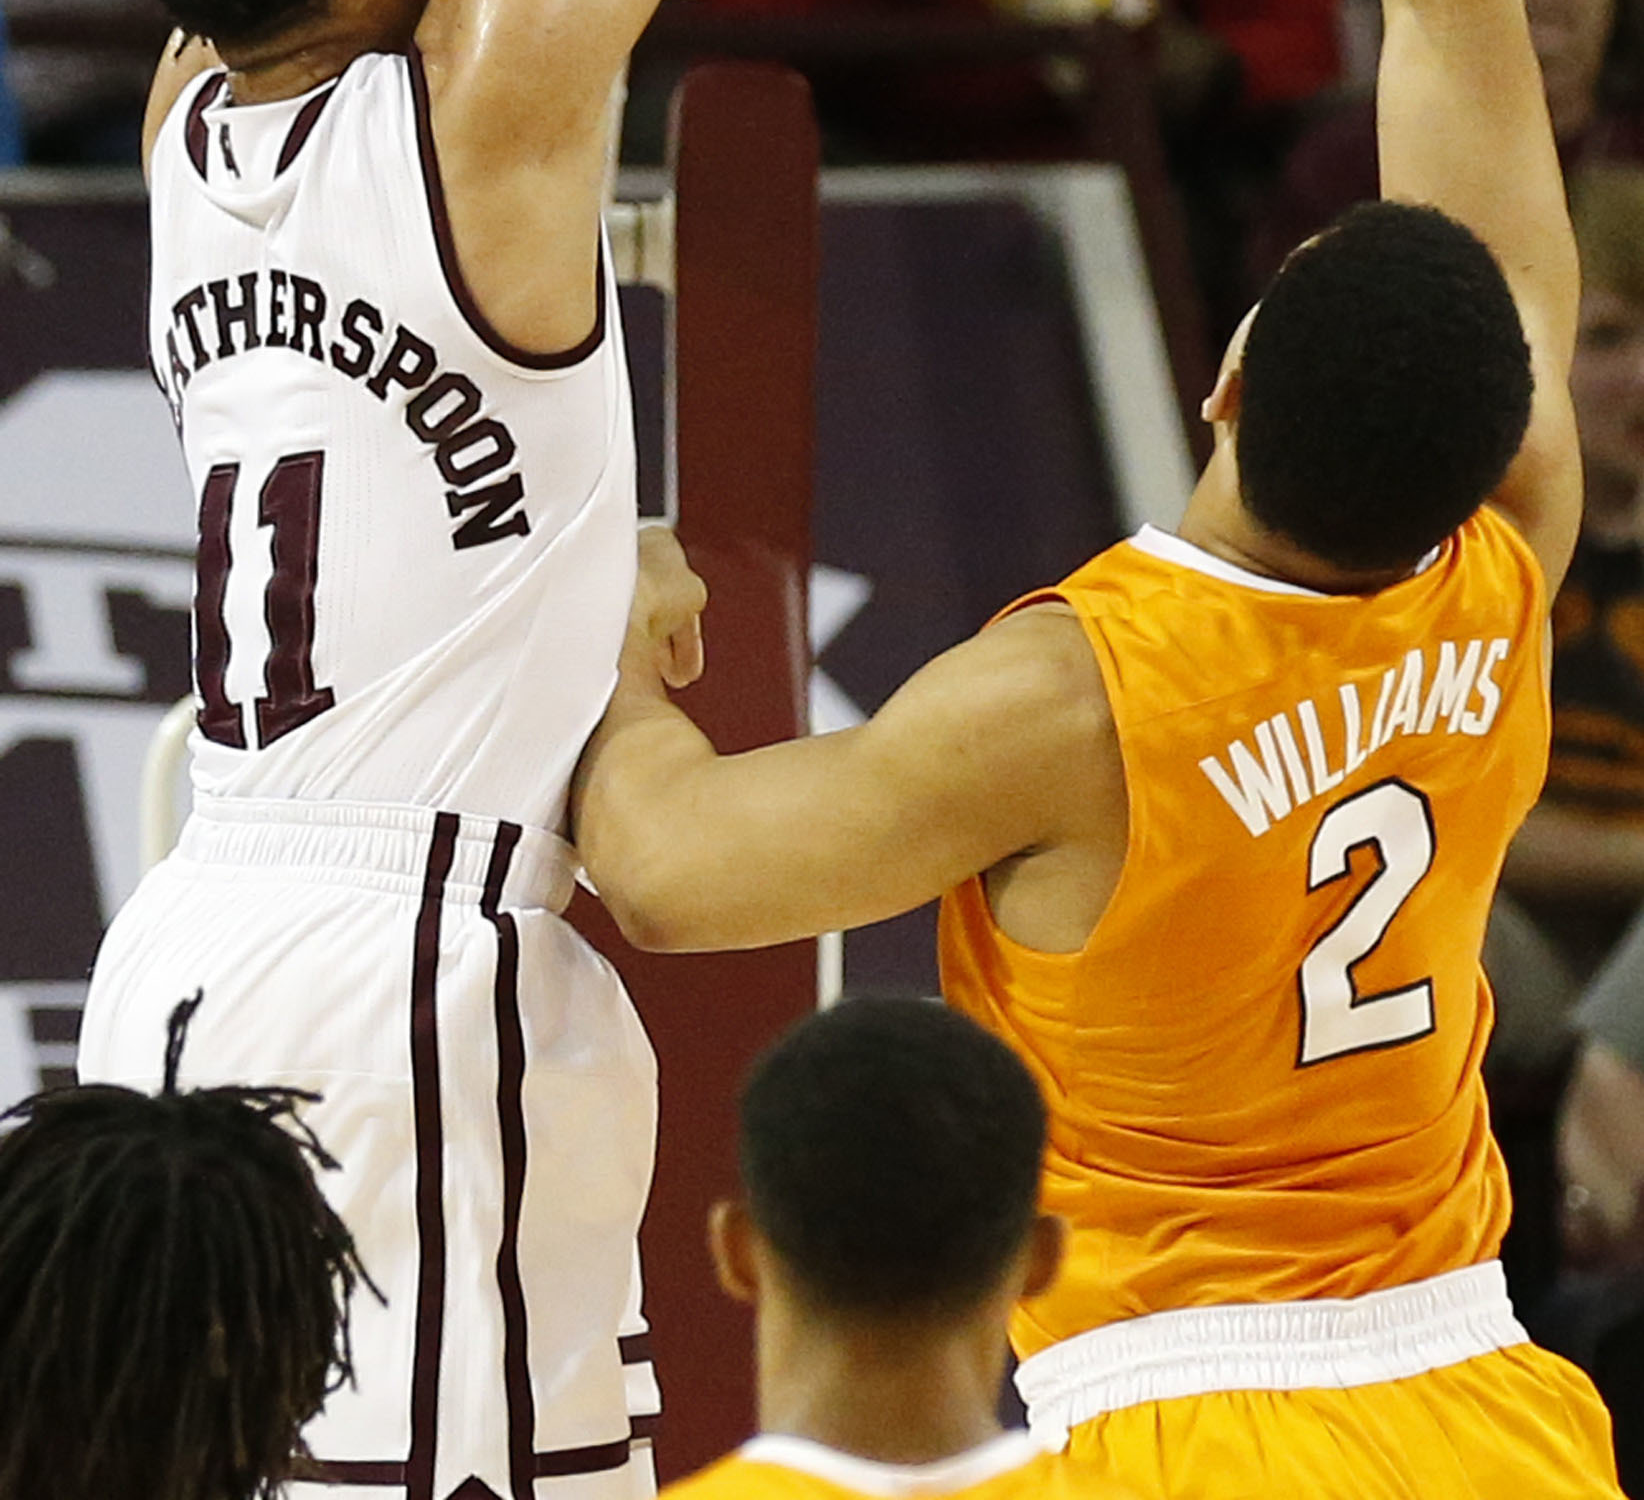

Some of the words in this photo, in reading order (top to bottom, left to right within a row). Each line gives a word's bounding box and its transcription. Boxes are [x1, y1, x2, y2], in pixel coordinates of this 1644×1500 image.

[196, 450, 335, 751] 11
[1198, 637, 1510, 838] WILLIAMS
[1295, 775, 1437, 1069] 2
